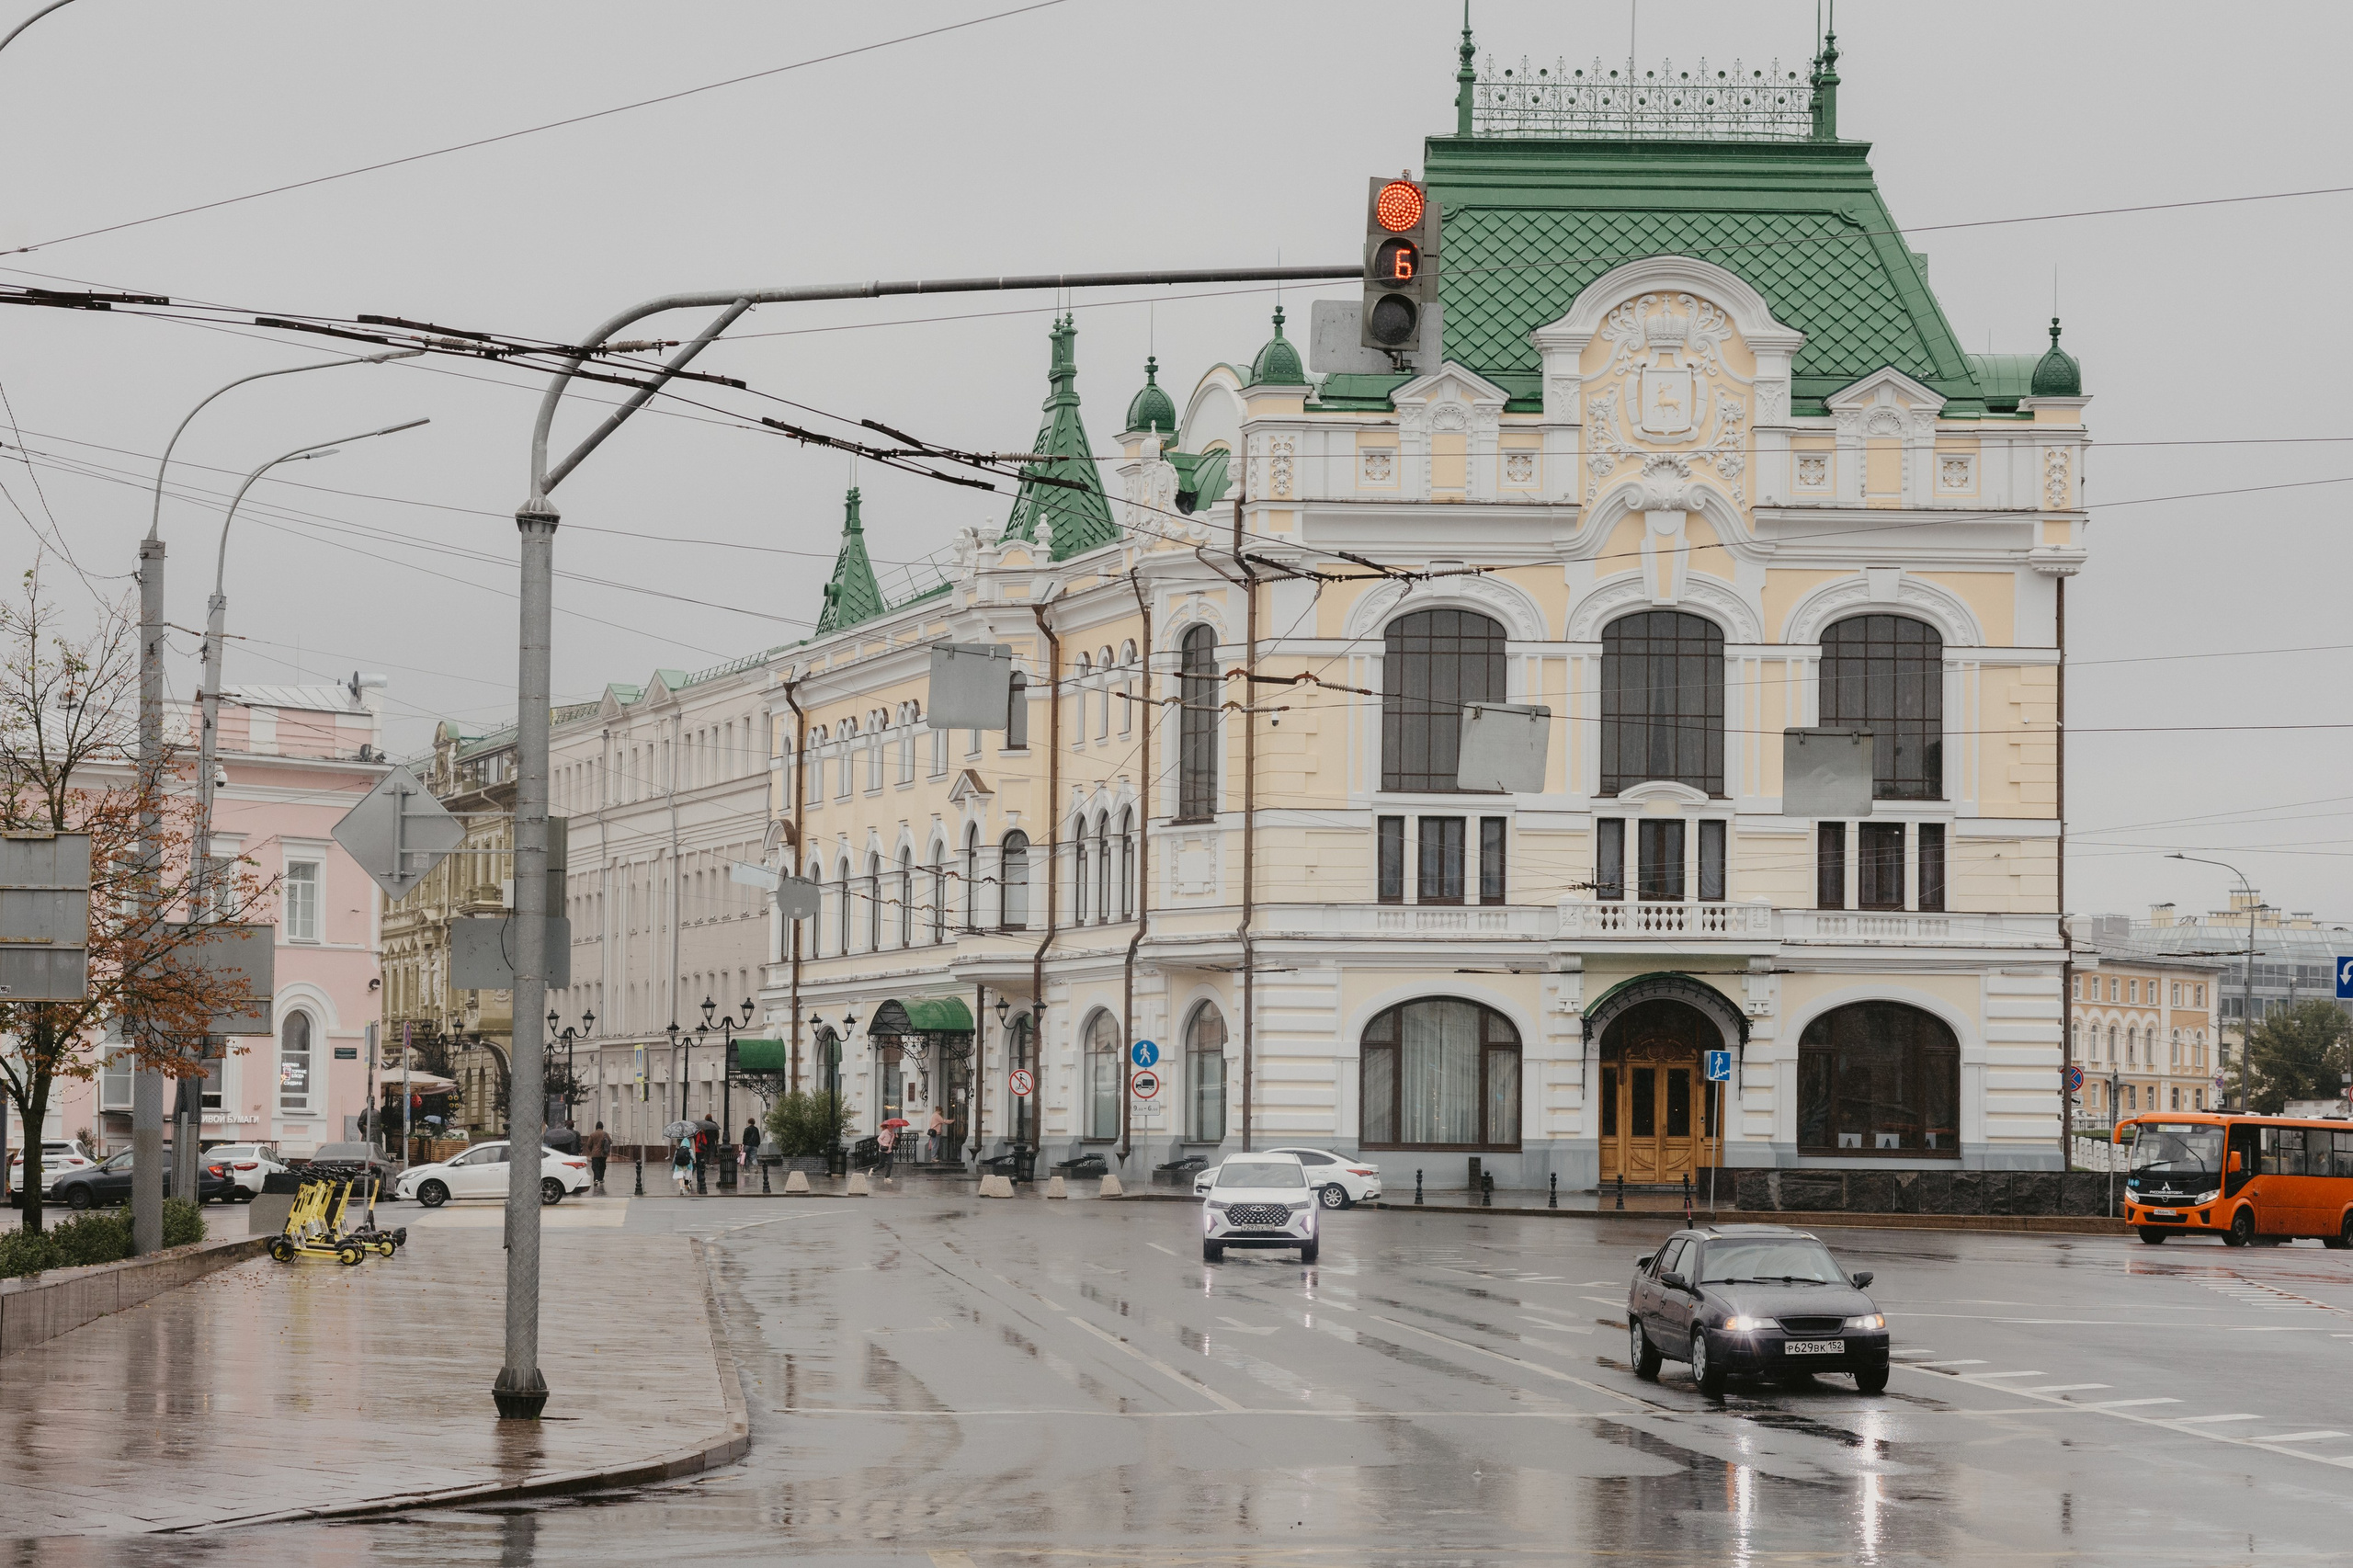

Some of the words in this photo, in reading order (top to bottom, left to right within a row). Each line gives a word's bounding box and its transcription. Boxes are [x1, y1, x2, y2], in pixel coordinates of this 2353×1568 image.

[1395, 248, 1412, 279] 6
[227, 1115, 259, 1123] БУМАГИ
[1788, 1342, 1826, 1353] Р629ВК
